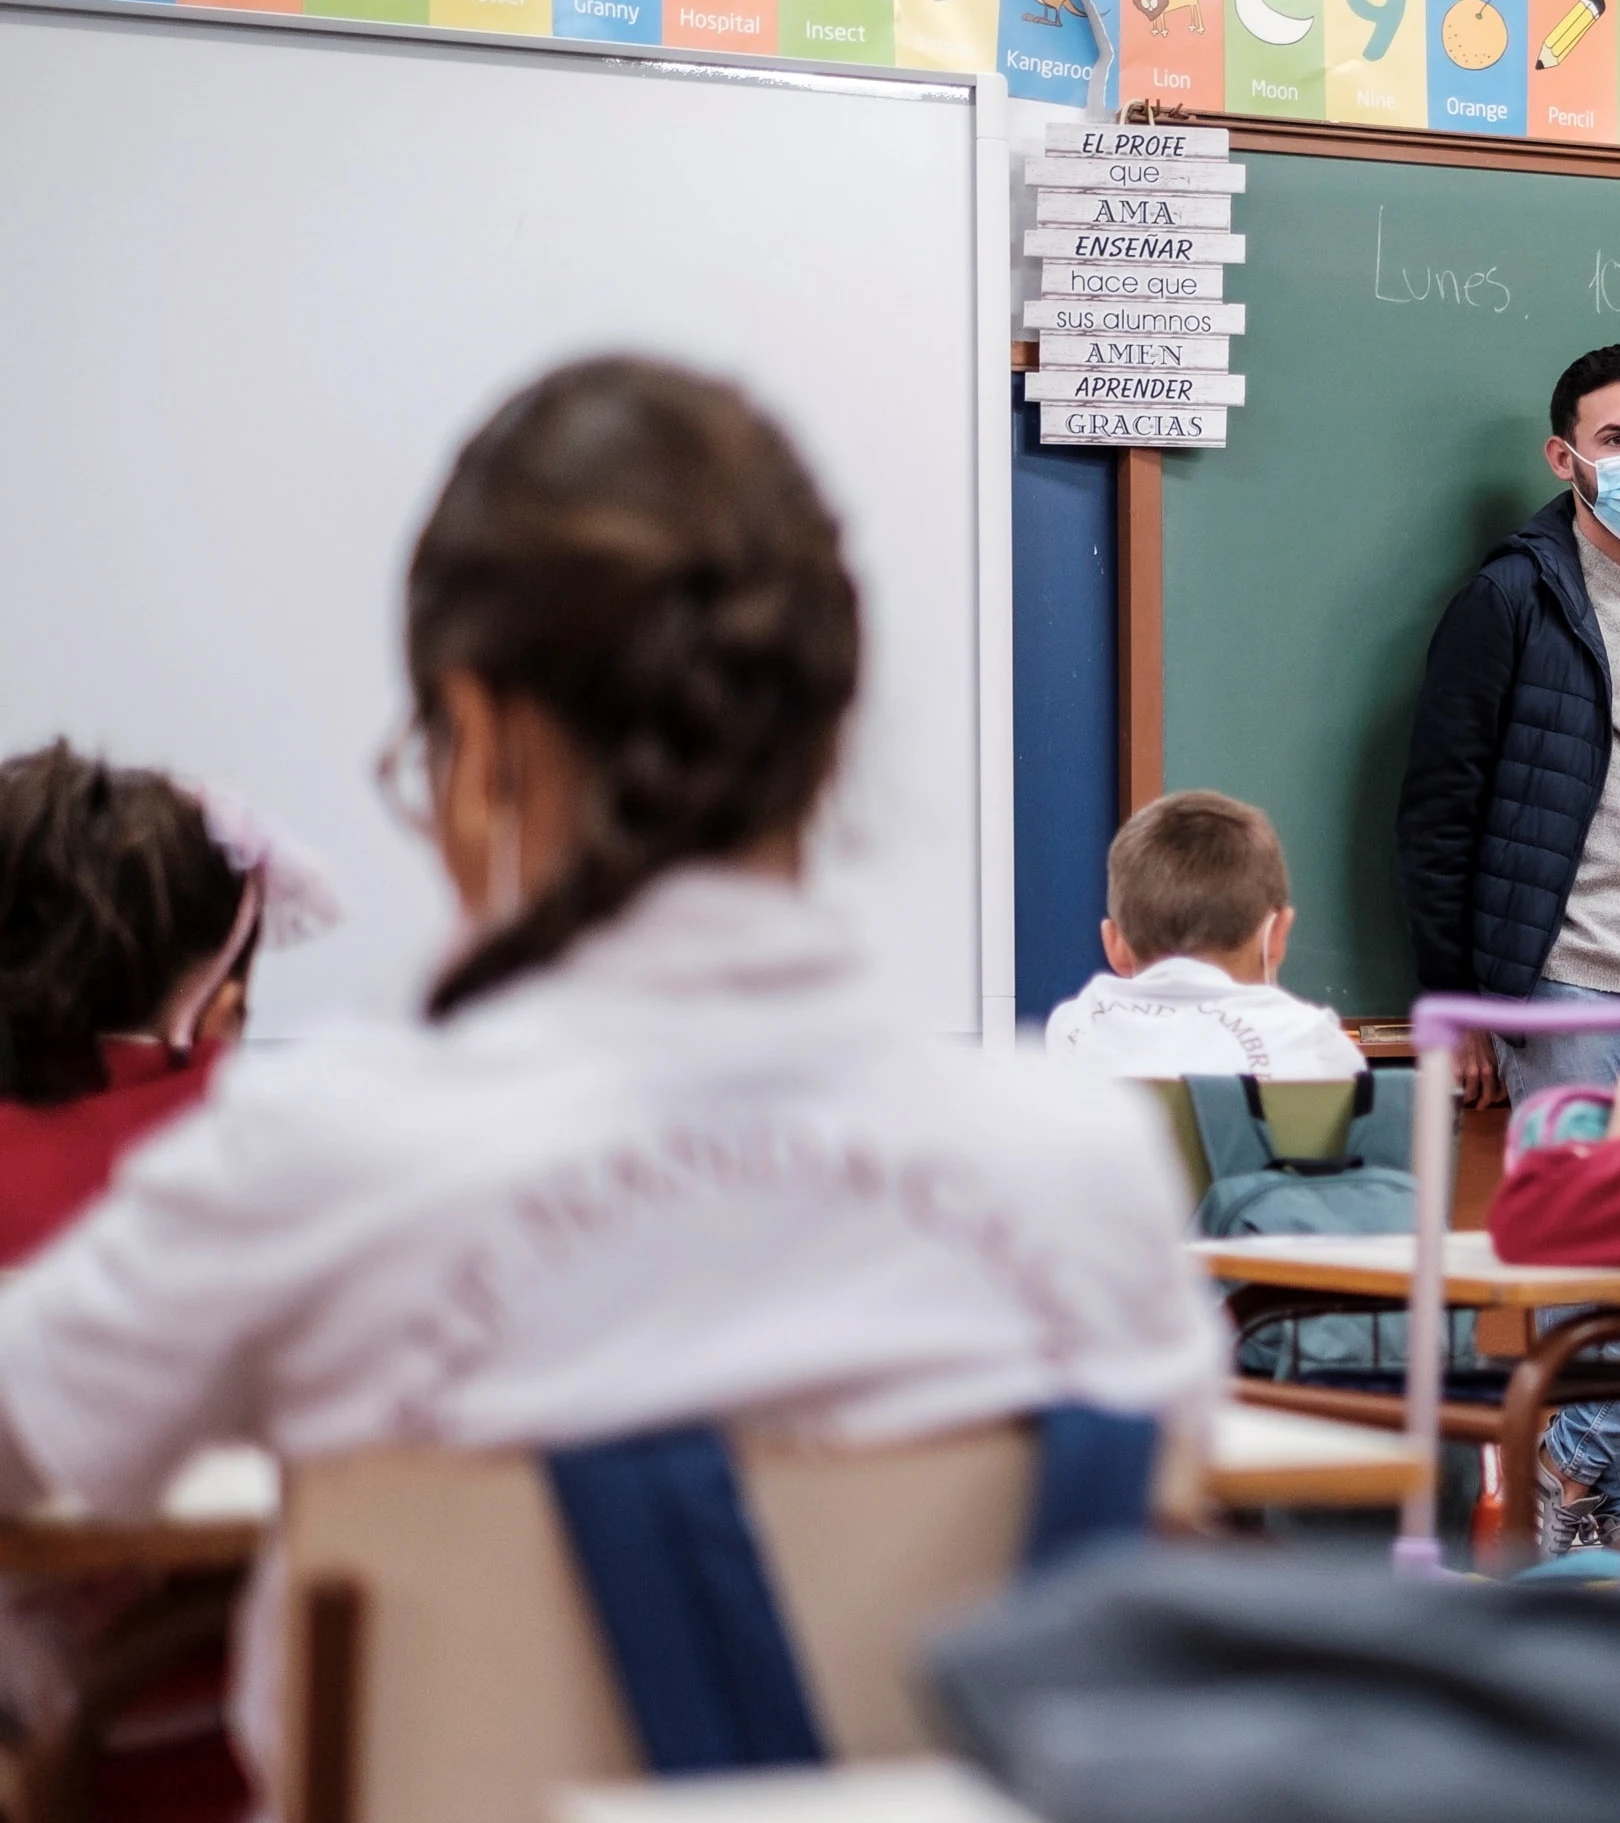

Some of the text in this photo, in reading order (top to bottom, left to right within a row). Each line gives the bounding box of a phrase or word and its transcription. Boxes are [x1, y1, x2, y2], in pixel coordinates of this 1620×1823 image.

[574, 0, 640, 25] Granny
[680, 8, 761, 35] Hospital
[806, 20, 867, 43] Insect
[1006, 49, 1093, 82] Kangaroo
[1153, 68, 1191, 90] Lion
[1251, 79, 1299, 101] Moon
[1356, 87, 1398, 111] Nine
[1446, 97, 1508, 121] Orange
[1548, 107, 1595, 129] Pencil
[1082, 133, 1186, 157] EL PROFE
[1109, 164, 1159, 186] que
[1092, 199, 1176, 226] AMA
[1075, 233, 1193, 261] ENSEÑAR
[1071, 270, 1197, 299] hace que
[1056, 309, 1212, 332] sus alumnos
[1084, 342, 1183, 366] AMEN
[1075, 376, 1193, 401] APRENDER
[1065, 413, 1203, 438] GRACIAS
